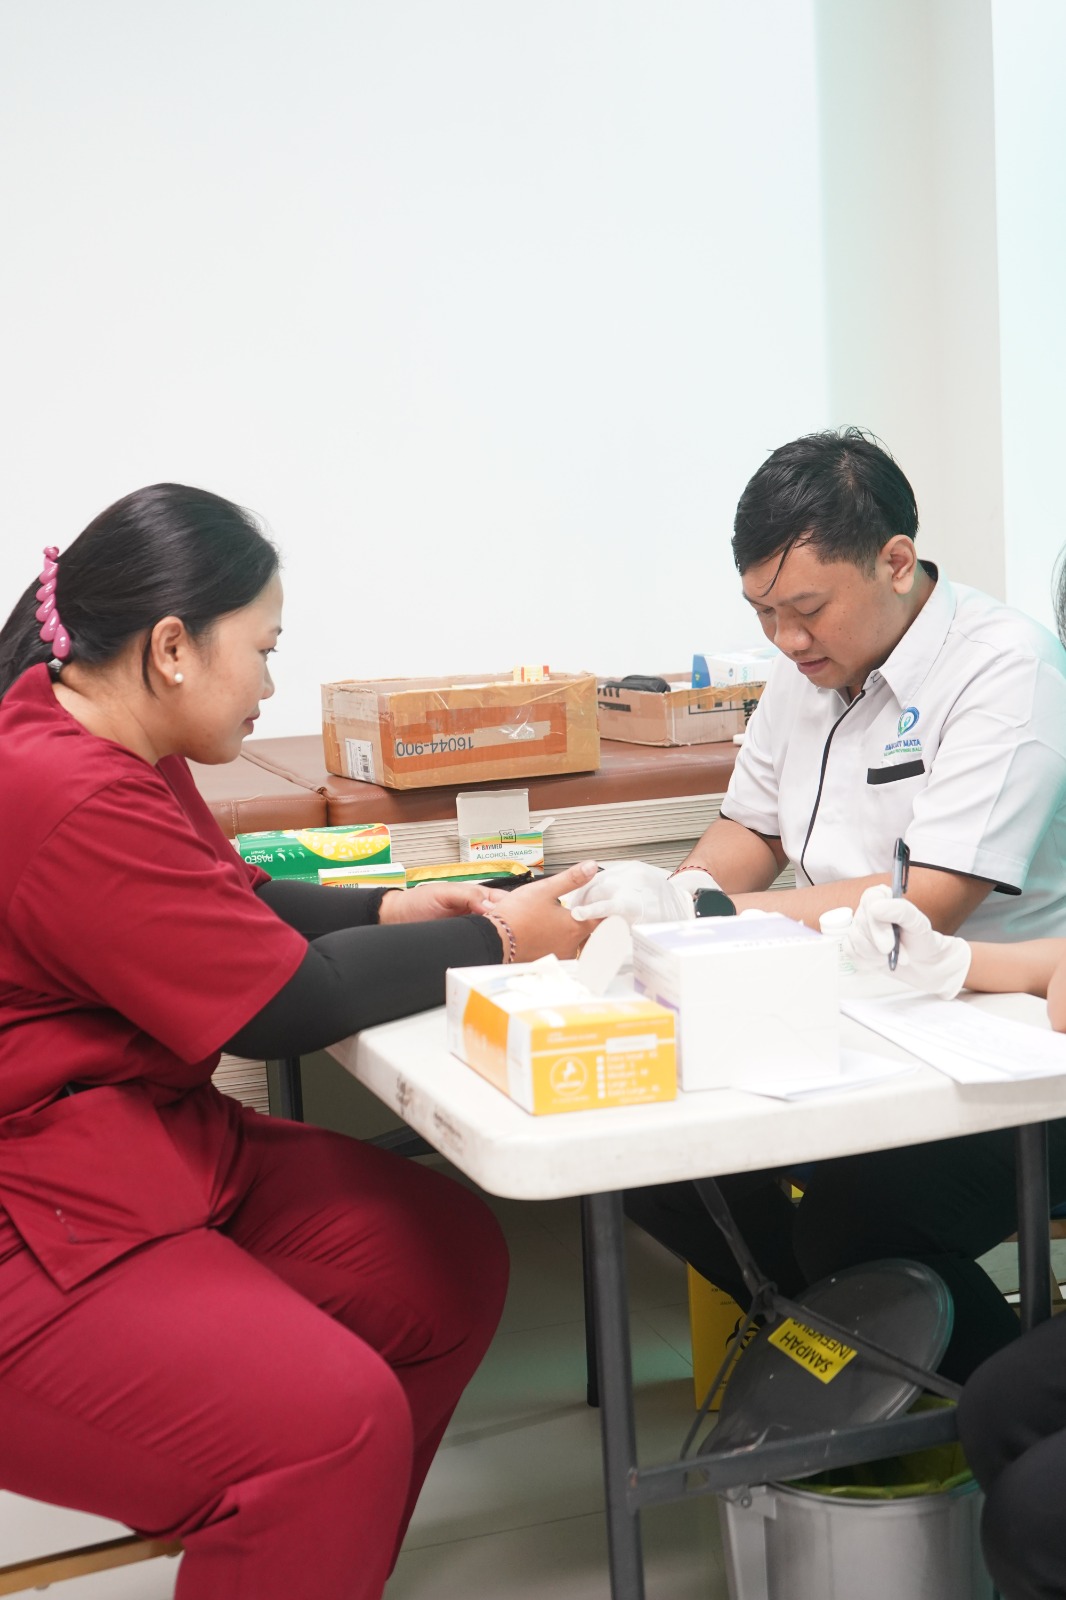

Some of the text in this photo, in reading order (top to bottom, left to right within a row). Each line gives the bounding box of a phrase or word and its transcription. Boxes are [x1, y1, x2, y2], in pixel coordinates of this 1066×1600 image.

[396, 736, 474, 757] 16044-900
[903, 739, 921, 748] MATA
[244, 853, 273, 865] PASEO
[779, 1330, 834, 1374] SAMPAH
